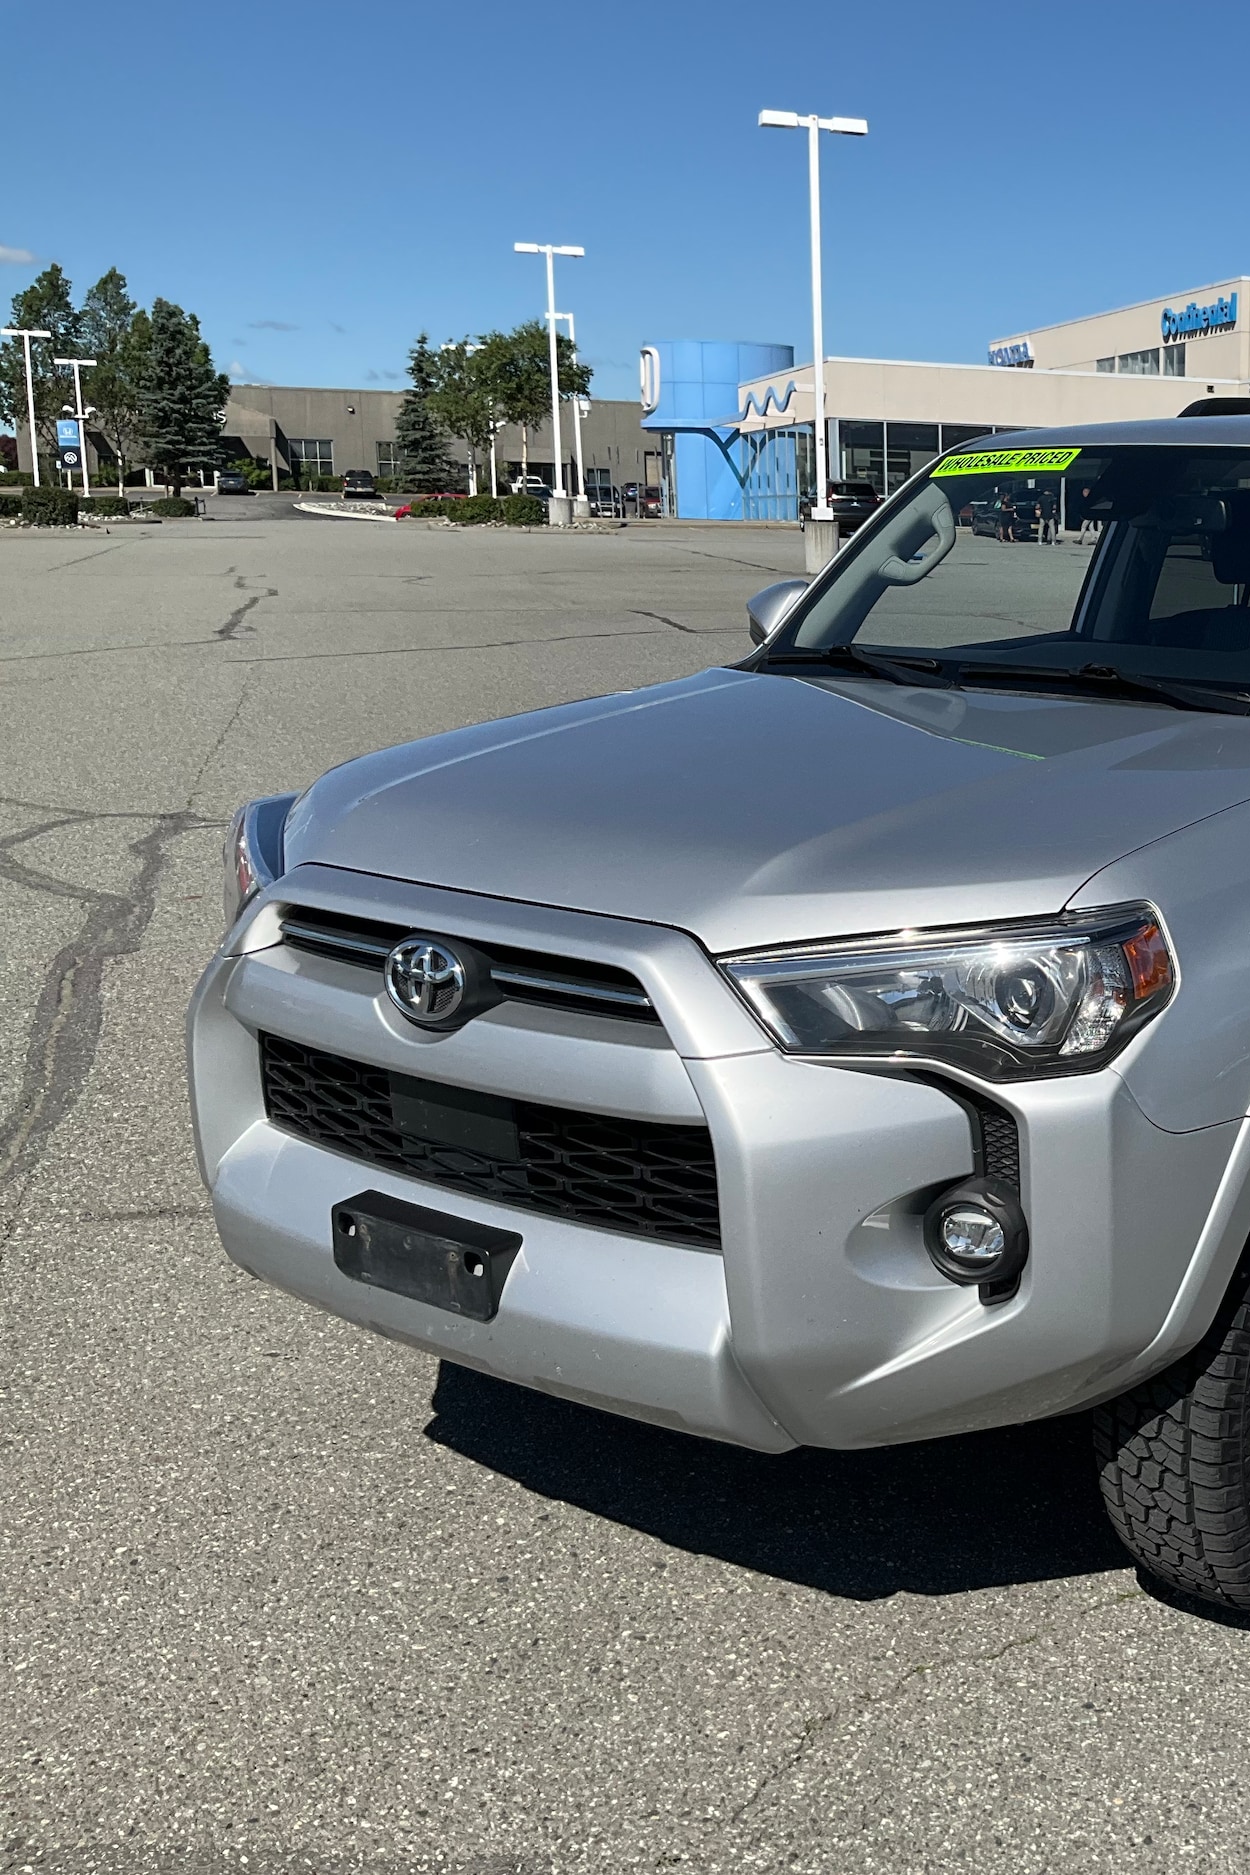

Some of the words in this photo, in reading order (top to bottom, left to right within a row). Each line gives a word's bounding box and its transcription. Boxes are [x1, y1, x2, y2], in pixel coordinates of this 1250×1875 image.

[1161, 292, 1237, 337] Continental
[938, 452, 1021, 472] WHOLESALE
[1016, 450, 1075, 466] PRICED
